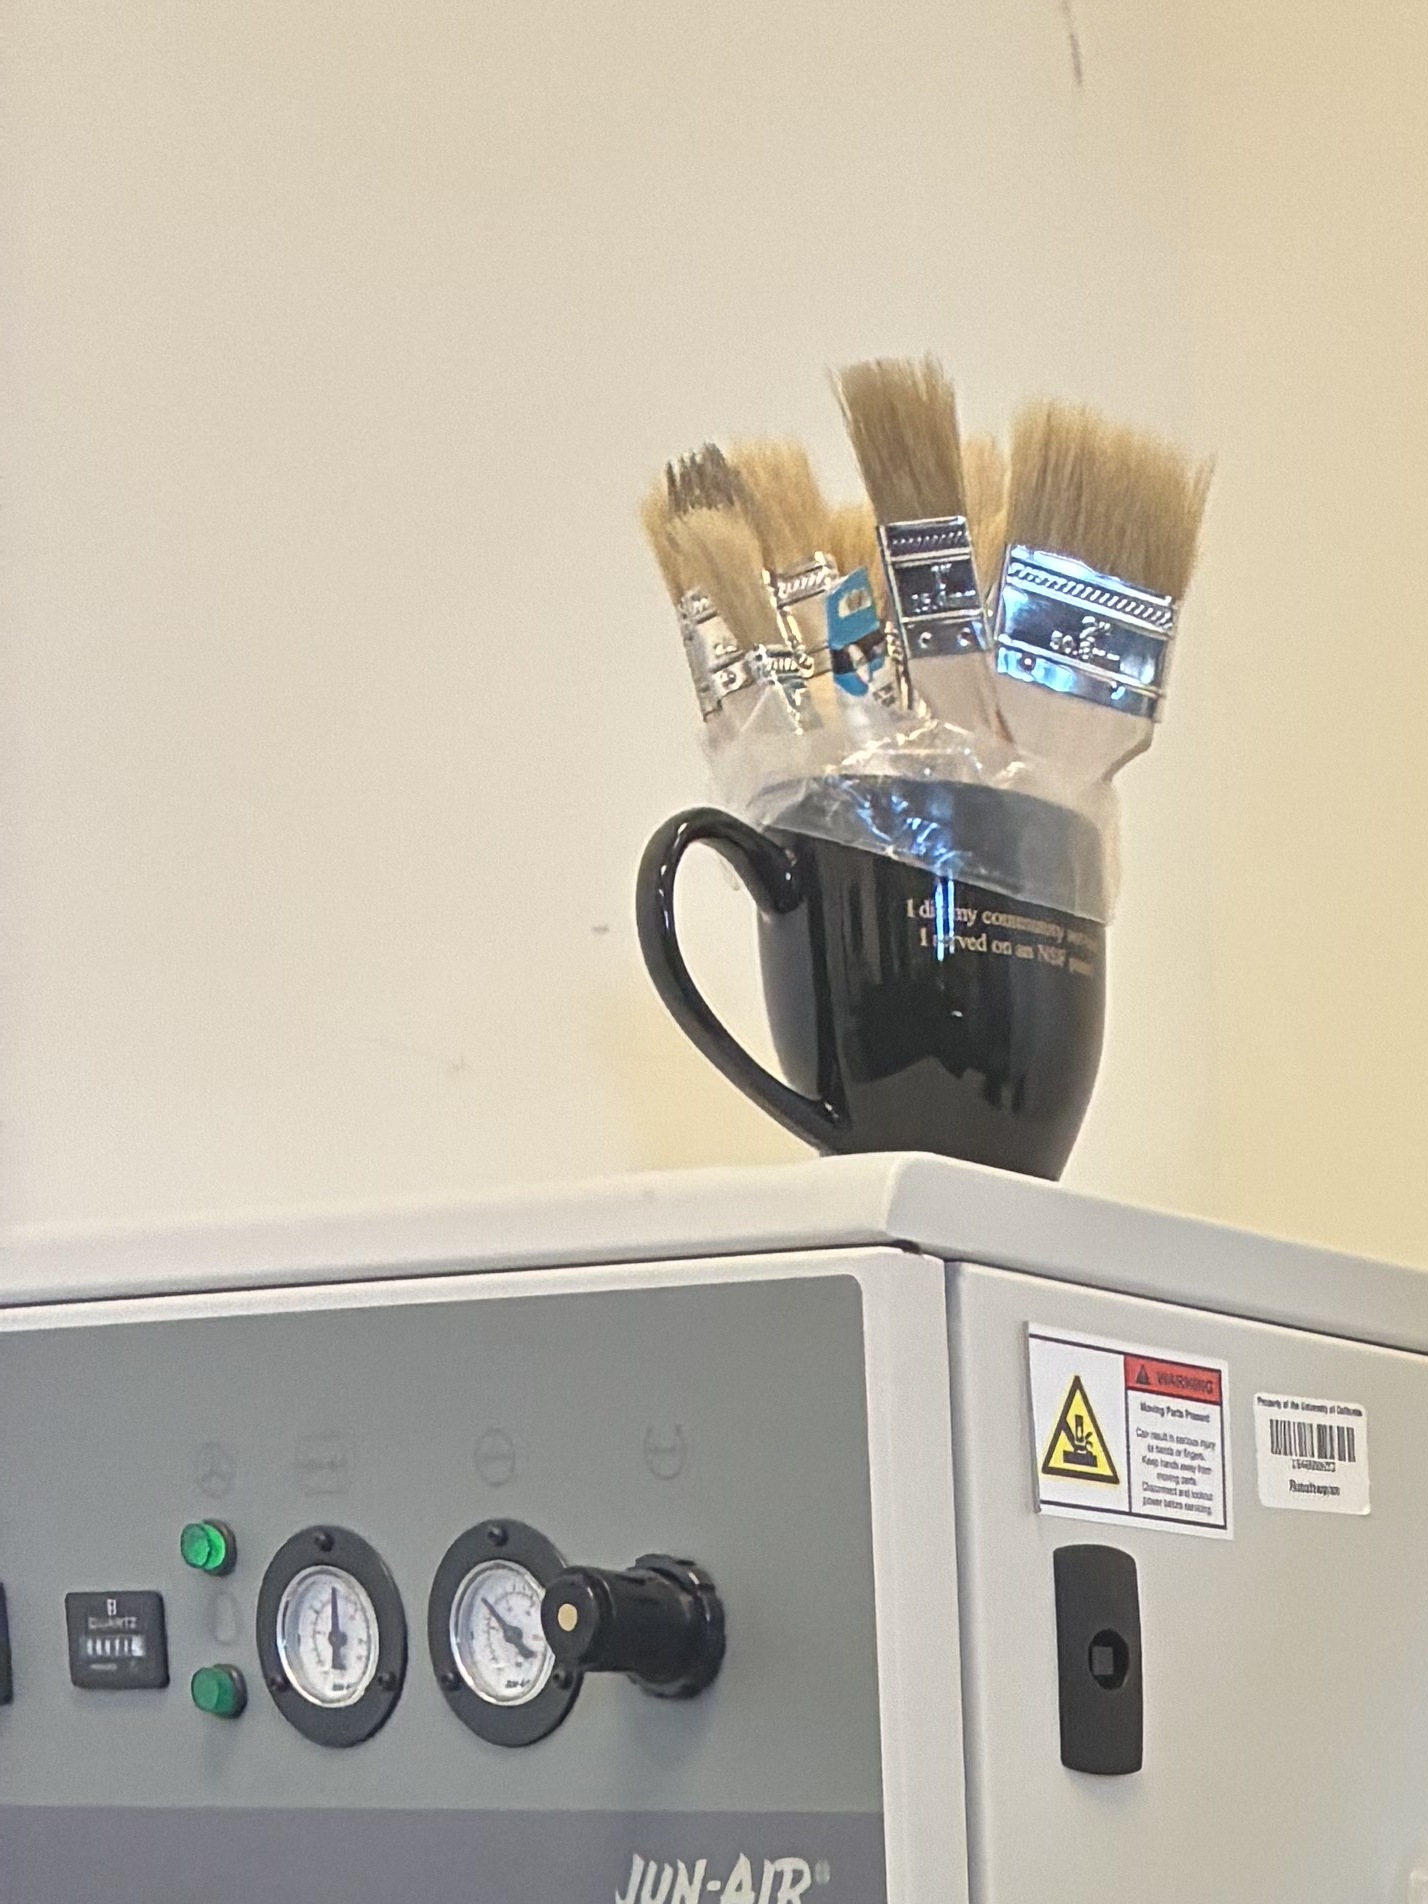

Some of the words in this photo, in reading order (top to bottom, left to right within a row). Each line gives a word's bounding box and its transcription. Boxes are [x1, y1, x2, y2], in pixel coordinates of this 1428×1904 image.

[906, 898, 915, 918] I
[919, 927, 928, 947] I
[1157, 1371, 1214, 1394] WARNING
